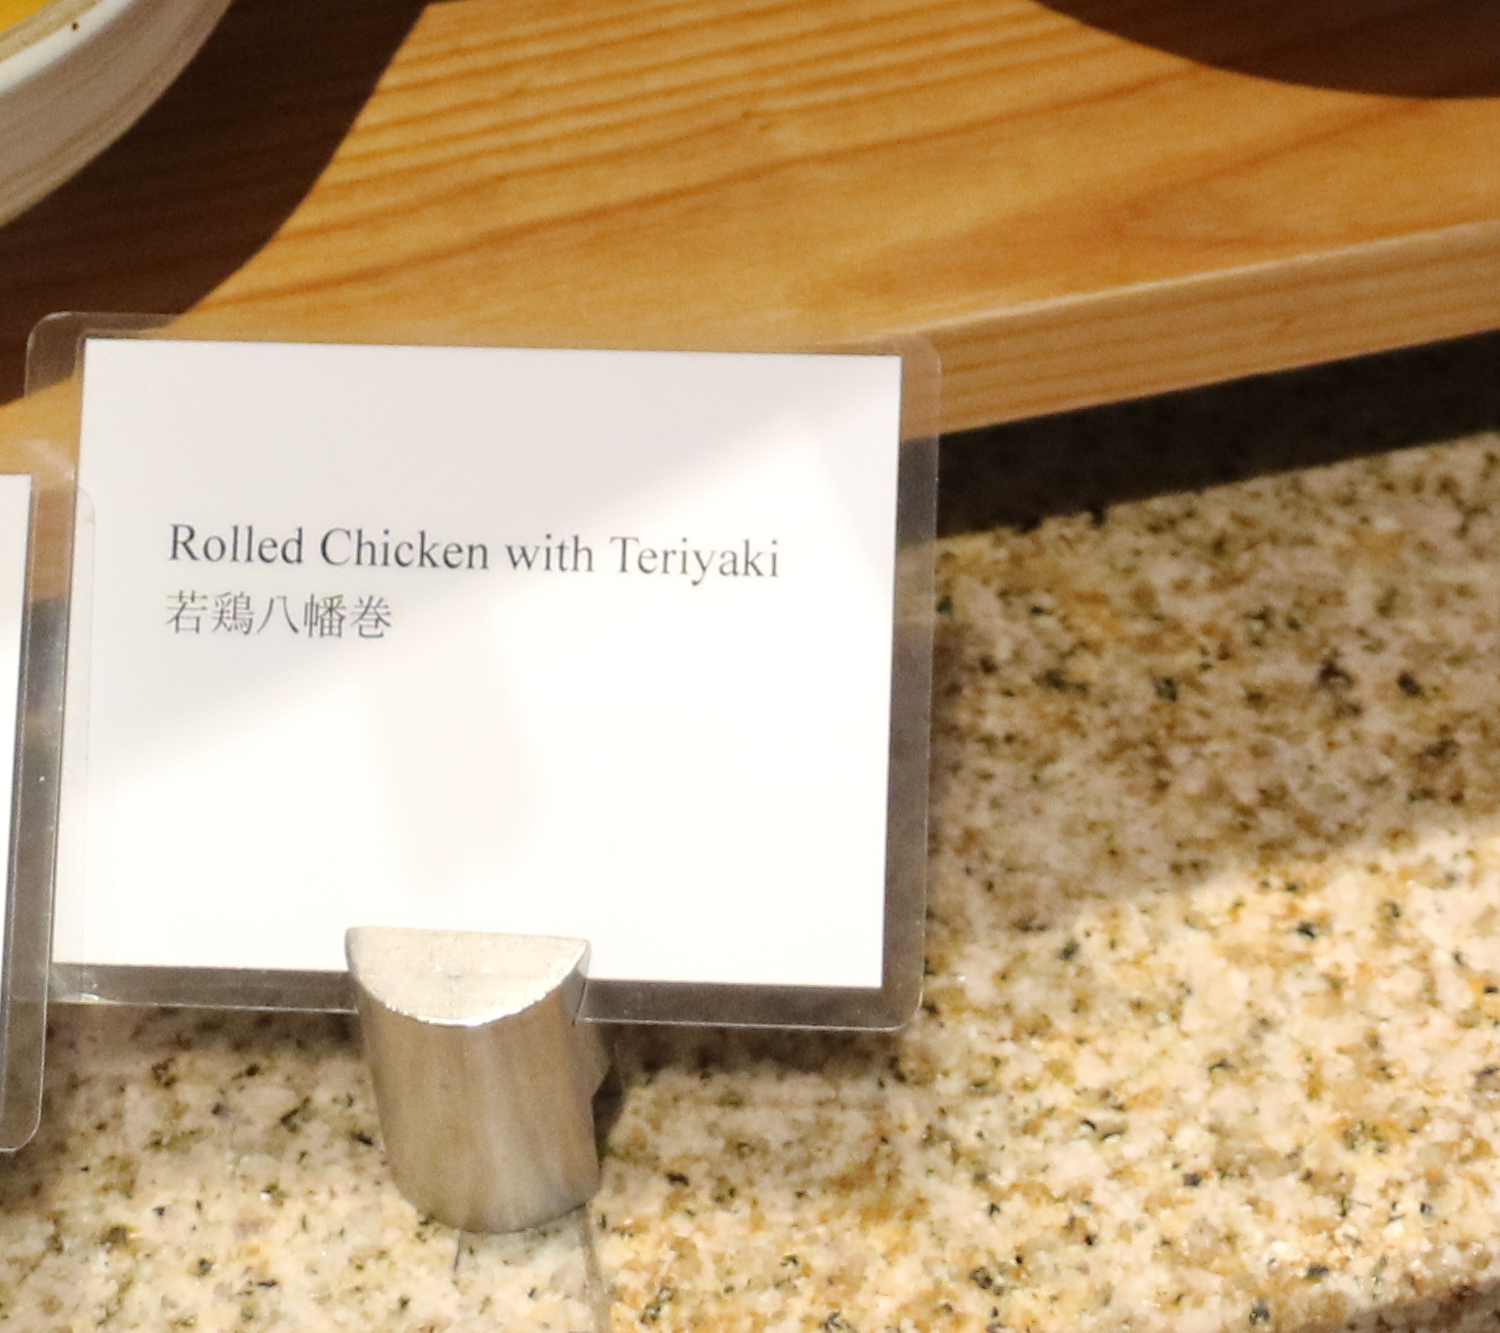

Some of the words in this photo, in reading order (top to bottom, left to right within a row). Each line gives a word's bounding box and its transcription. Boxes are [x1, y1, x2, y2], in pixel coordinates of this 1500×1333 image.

[168, 523, 303, 566] Rolled
[320, 527, 490, 572] Chicken
[506, 532, 596, 574] with
[608, 536, 781, 587] Teriyaki
[165, 589, 393, 639] 若鶏八幡巻
